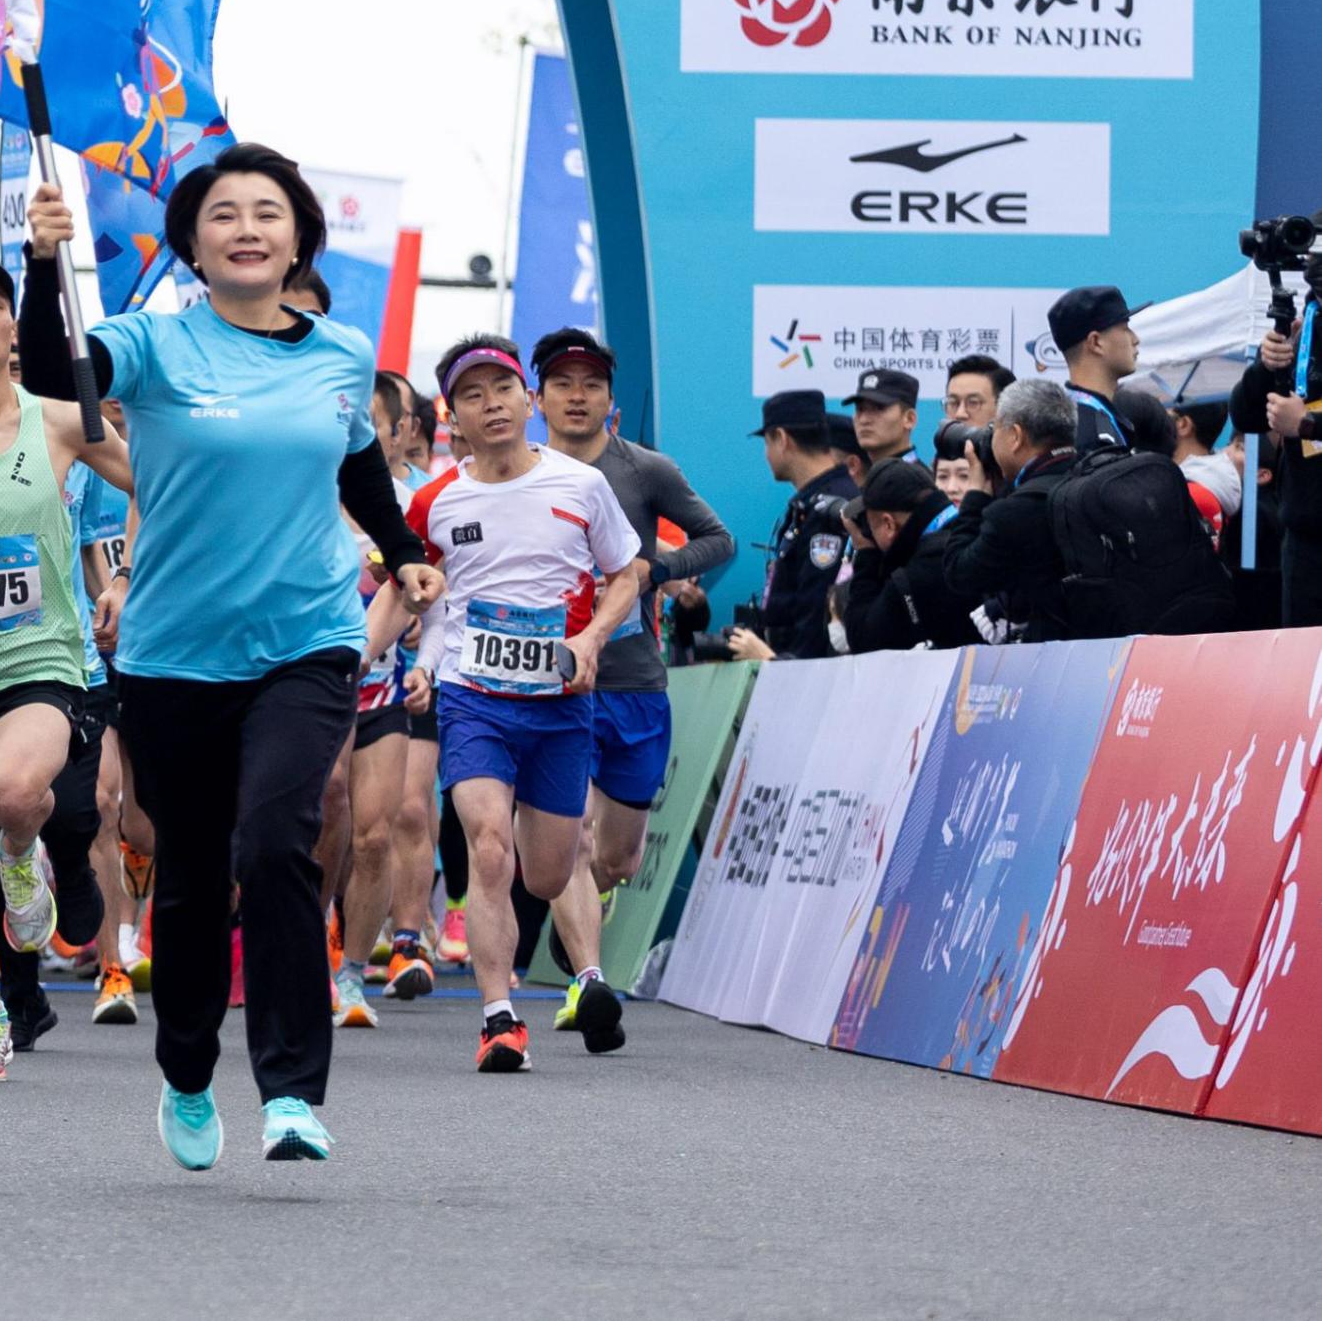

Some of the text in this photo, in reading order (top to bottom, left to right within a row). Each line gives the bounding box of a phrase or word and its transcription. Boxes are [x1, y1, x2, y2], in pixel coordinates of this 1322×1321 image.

[871, 25, 1142, 49] BANK OF NANJING
[850, 190, 1027, 224] ERKE
[833, 327, 1001, 353] 中国体育彩票
[834, 357, 875, 370] CHINA
[879, 357, 934, 370] SPORTS
[189, 407, 241, 420] ERKE
[473, 633, 555, 673] 10391
